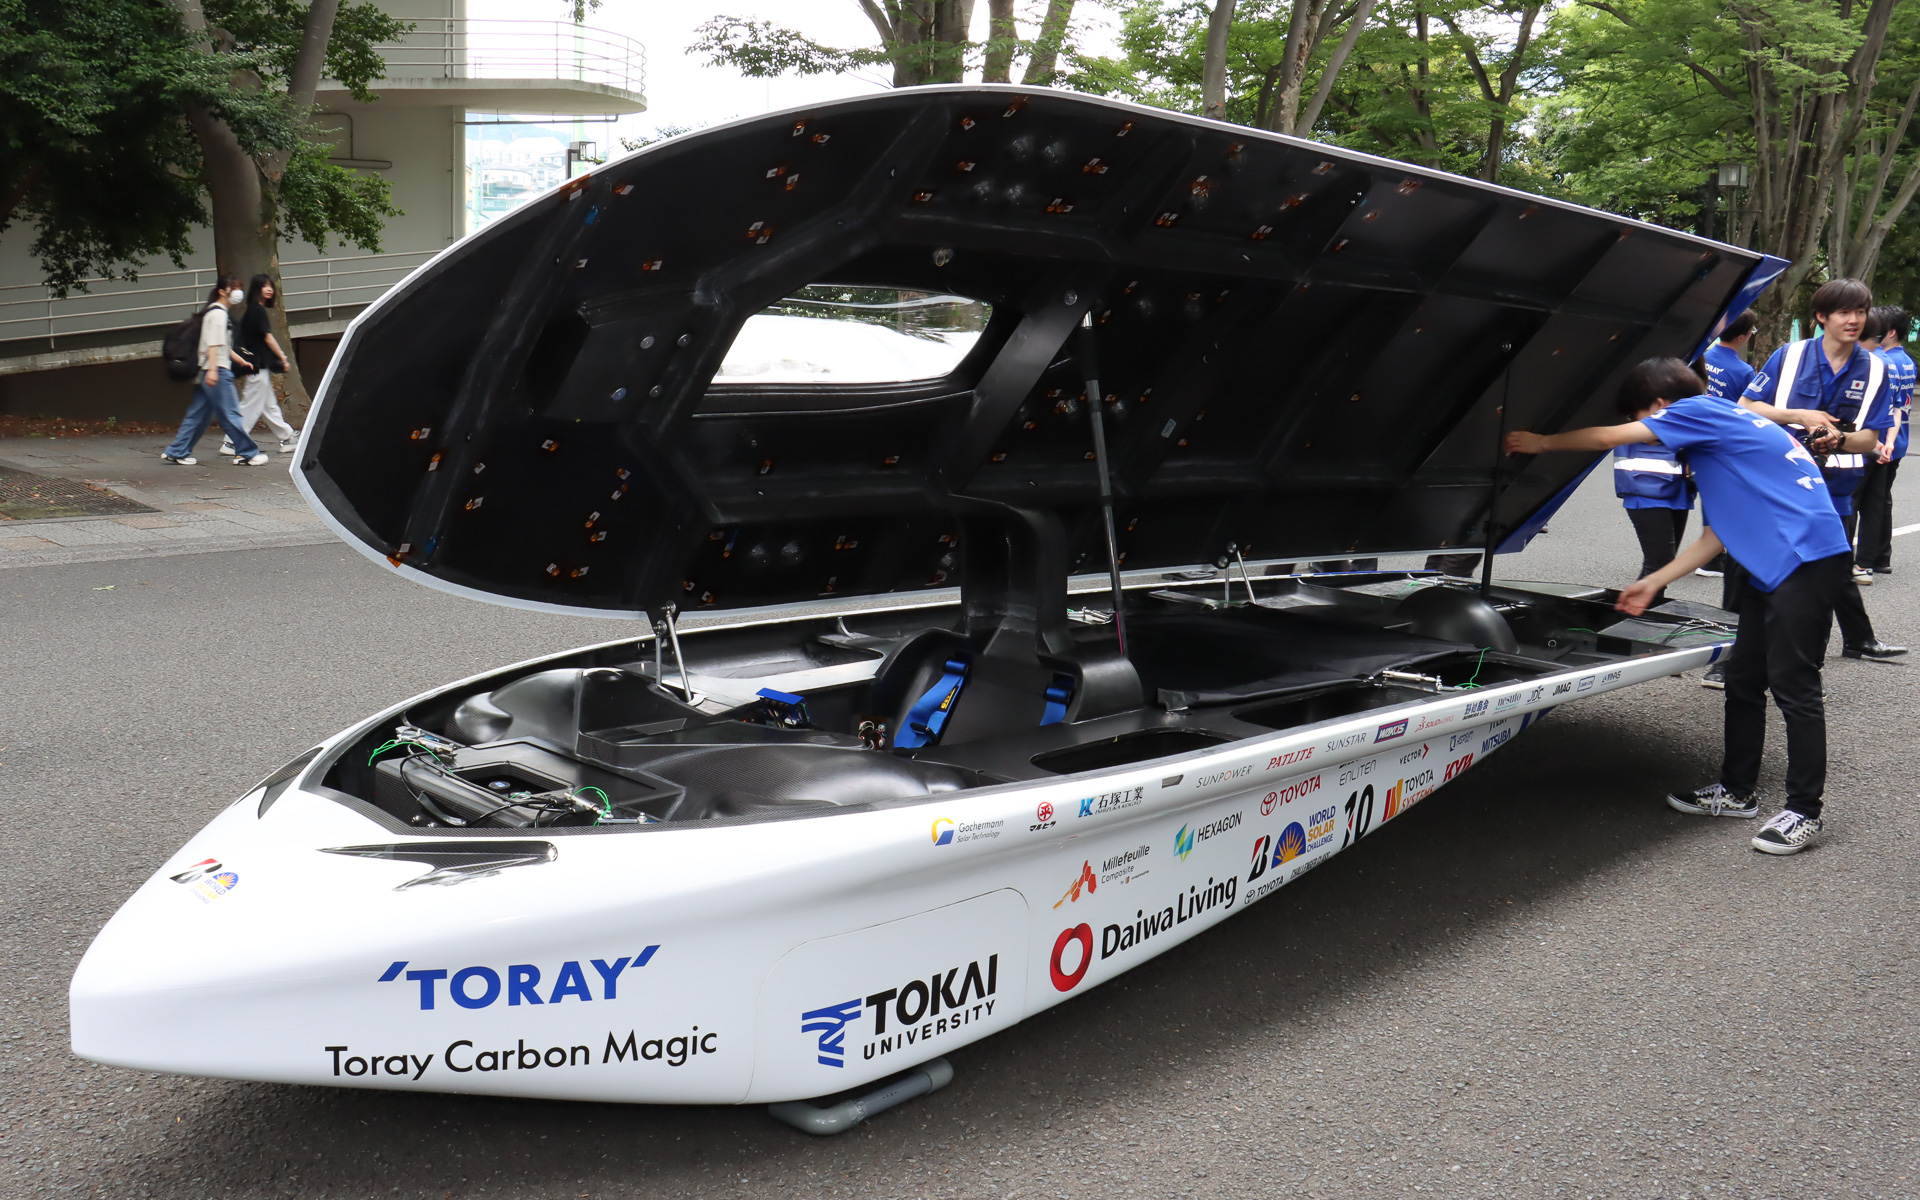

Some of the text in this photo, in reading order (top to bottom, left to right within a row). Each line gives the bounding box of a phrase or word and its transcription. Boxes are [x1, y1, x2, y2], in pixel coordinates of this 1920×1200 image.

[1705, 362, 1724, 375] ORAY
[1552, 682, 1571, 696] JMAG
[1326, 732, 1367, 752] SUNSTAR
[1481, 728, 1511, 754] MITSUBA
[1266, 747, 1315, 770] PATLITE
[1399, 749, 1422, 765] VECTOR
[1196, 765, 1252, 788] SUNPOWER
[1339, 759, 1376, 786] ENLITEN
[1405, 768, 1434, 793] TOYOTA
[1098, 786, 1144, 809] 石塚工業
[1280, 775, 1320, 806] TOYOTA
[959, 819, 1003, 833] Gochermann
[1197, 811, 1243, 843] HEXAGON
[1309, 805, 1336, 827] WORLD
[1340, 784, 1374, 849] 10
[957, 830, 1001, 843] Solar Technology
[1308, 819, 1335, 842] SOLAR
[1307, 834, 1333, 853] CHALLENGE
[1102, 844, 1150, 873] Millefeuille
[1101, 865, 1134, 884] Composite
[1257, 875, 1284, 897] TOYOTA
[204, 878, 226, 895] WORLD
[406, 957, 632, 1010] TORAY
[866, 953, 998, 1035] TOKAI
[863, 1000, 995, 1060] UNIVERSITY
[325, 1025, 717, 1080] Toray Carbon Magic
